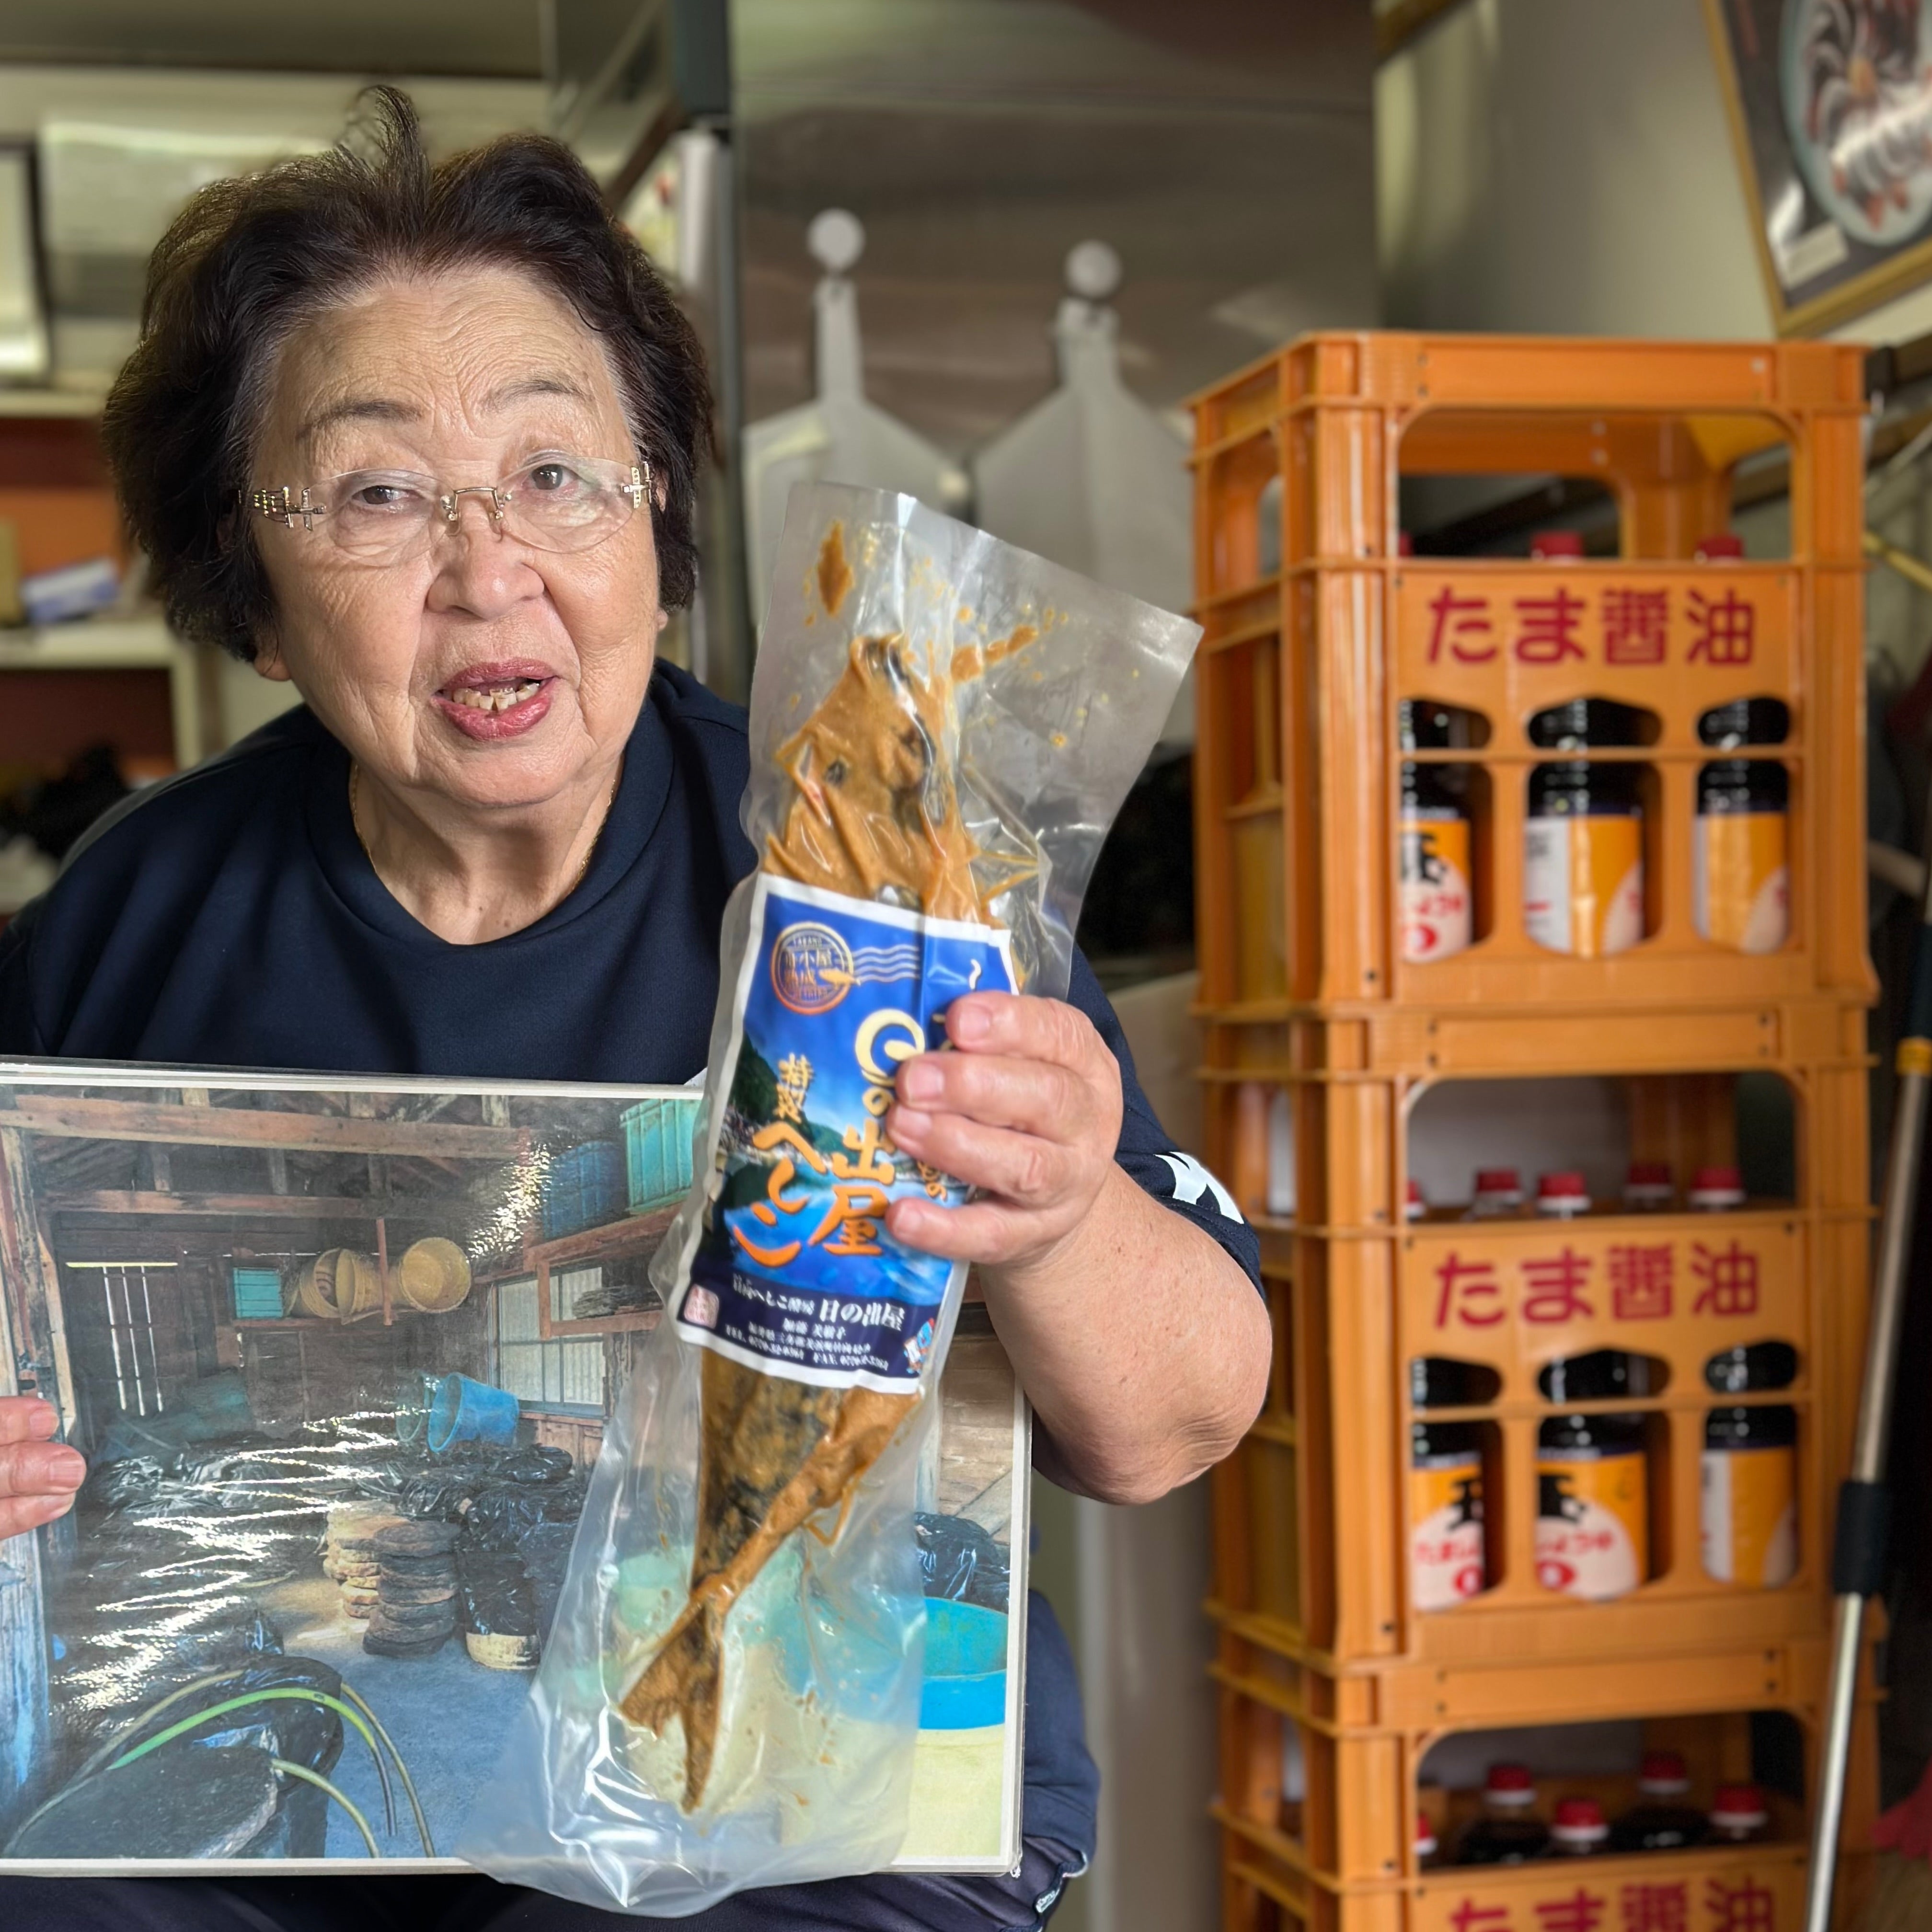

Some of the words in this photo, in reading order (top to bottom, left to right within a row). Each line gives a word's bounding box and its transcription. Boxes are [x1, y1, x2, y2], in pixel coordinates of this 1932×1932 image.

[1427, 586, 1756, 666] たま醤油
[1434, 1239, 1760, 1330] たま醤油
